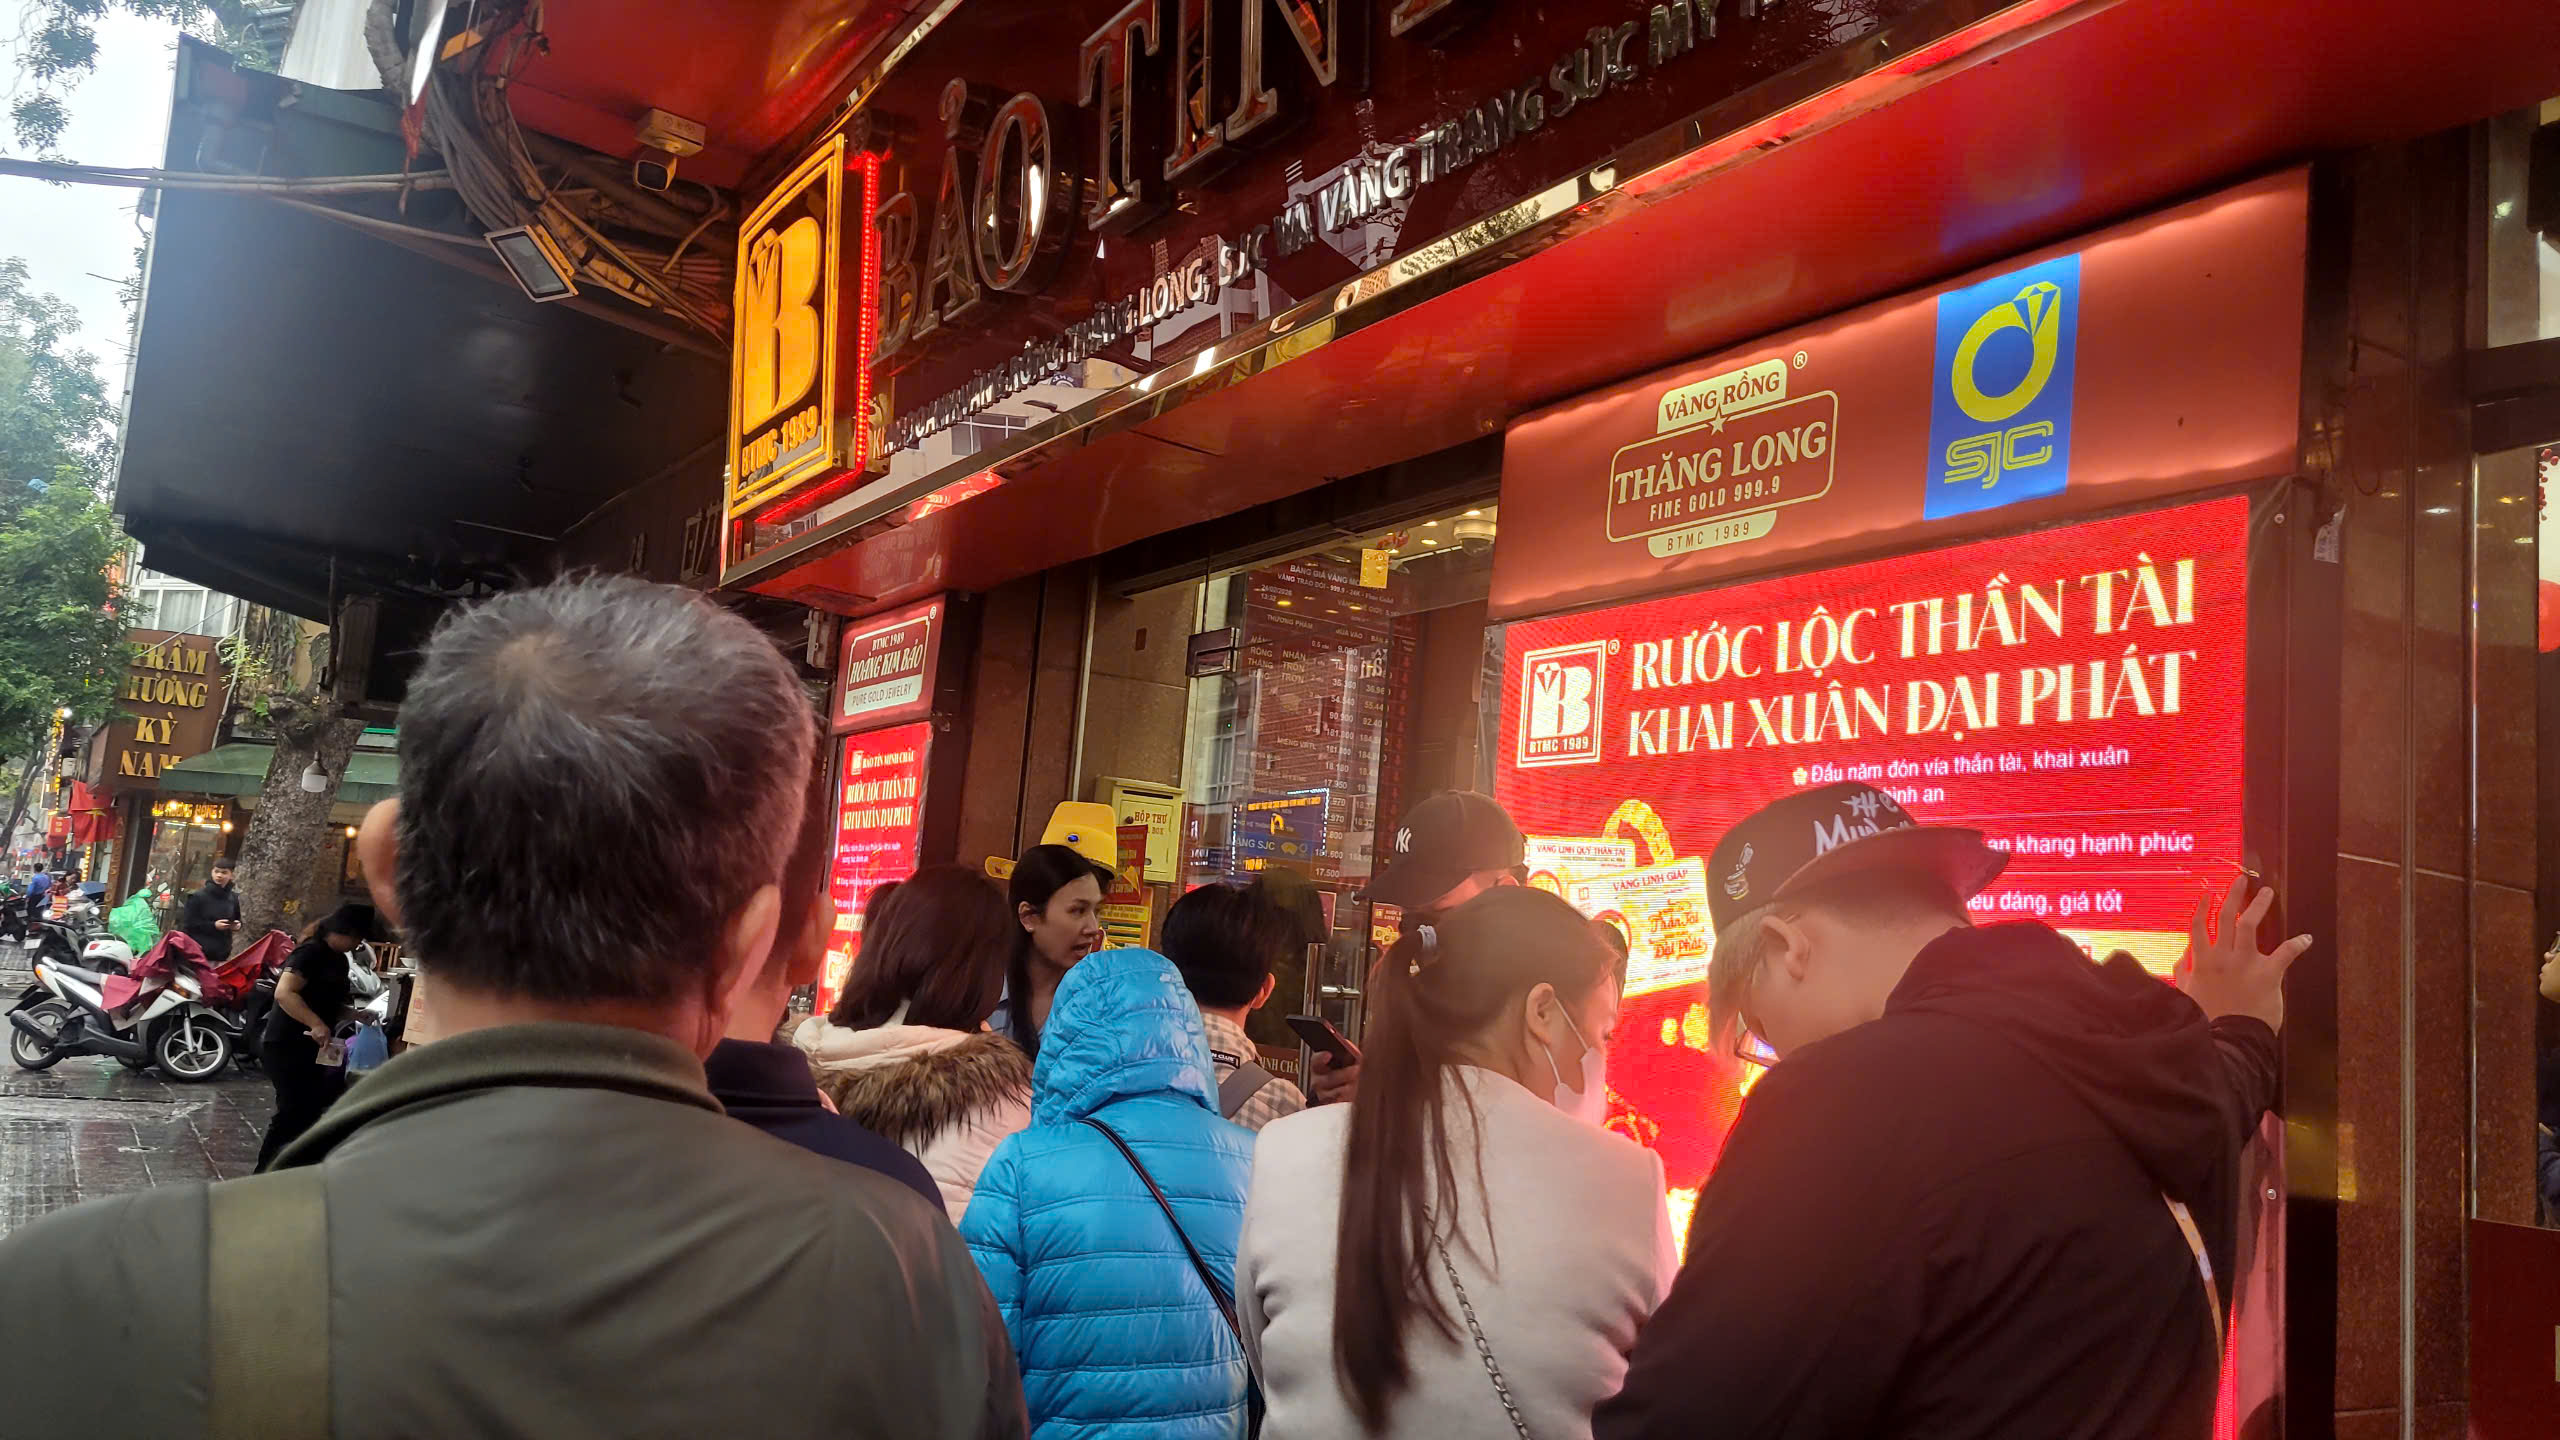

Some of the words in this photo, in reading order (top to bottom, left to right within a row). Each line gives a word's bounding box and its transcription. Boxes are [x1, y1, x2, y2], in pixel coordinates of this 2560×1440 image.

[1218, 224, 1270, 287] SJC
[1320, 145, 1414, 233] VÀNG
[1416, 76, 1544, 184] TRANG
[1549, 20, 1640, 118] SỨC
[867, 77, 1050, 368] BẢO
[1664, 389, 1717, 421] VÀNG
[1722, 371, 1780, 405] RỒNG
[741, 428, 778, 477] BTMC
[781, 405, 818, 453] 1989
[1944, 420, 2054, 489] SJC
[1614, 448, 1722, 504] THĂNG
[1731, 421, 1827, 477] LONG
[1650, 498, 1681, 521] FINE
[1689, 487, 1725, 512] GOLD
[1734, 475, 1780, 501] 999.9
[1667, 531, 1703, 551] BTMC
[1715, 521, 1749, 541] 1989
[1277, 573, 1295, 583] VÀNG
[1297, 577, 1313, 587] TRAO
[1631, 620, 1762, 691] RƯỚC
[1776, 605, 1876, 678] LỘC
[1889, 572, 2065, 659] THẦN
[2080, 551, 2195, 634] TÀI
[872, 635, 889, 651] BTMC
[890, 632, 905, 647] 1989
[850, 651, 882, 684] HOÀNG
[880, 649, 901, 676] KIM
[900, 638, 923, 672] BẢO
[852, 692, 867, 706] PURE
[868, 689, 885, 703] GOLD
[885, 682, 912, 700] JEWELRY
[1628, 701, 1734, 757] KHAI
[1746, 680, 1890, 747] XUÂN
[1906, 672, 2000, 740] ĐẠI
[2019, 644, 2197, 725] PHÁT
[134, 712, 178, 745] KỲ
[1529, 738, 1558, 753] BTMC
[1563, 736, 1589, 750] 1989
[1848, 762, 1882, 780] năm
[1887, 760, 1919, 778] đón
[1924, 756, 1949, 776] vía
[2033, 748, 2075, 769] khai
[2080, 744, 2129, 768] xuân
[1923, 787, 1945, 802] an
[1257, 840, 1275, 851] SJC
[1537, 845, 1557, 853] VÀNG
[1558, 845, 1575, 854] LINH
[2016, 835, 2076, 859] khang
[2082, 833, 2133, 855] hạnh
[2140, 829, 2193, 856] phúc
[1612, 877, 1640, 892] VÀNG
[1642, 874, 1664, 887] LINH
[1667, 869, 1688, 882] GIÁP
[2000, 890, 2053, 915] dáng,
[2060, 892, 2089, 915] giá
[2095, 889, 2122, 912] tốt
